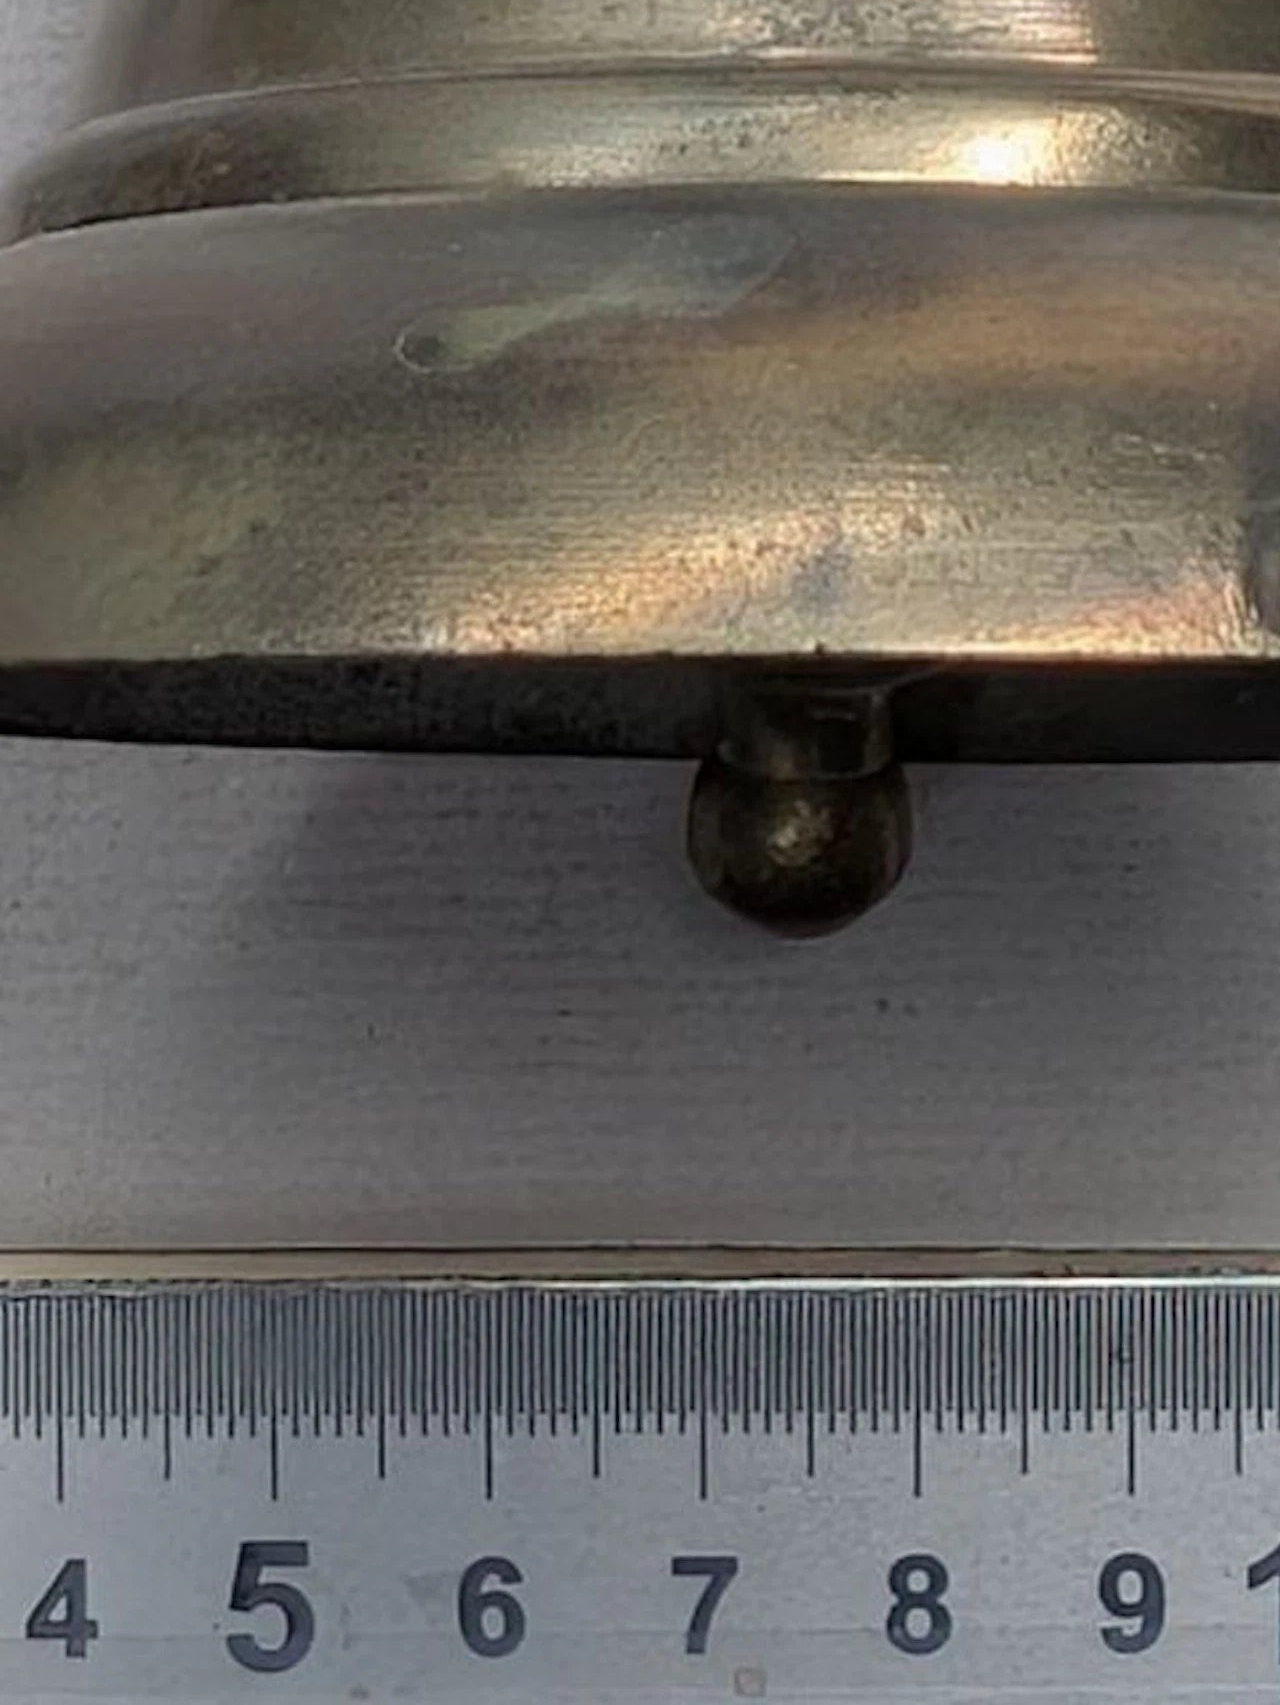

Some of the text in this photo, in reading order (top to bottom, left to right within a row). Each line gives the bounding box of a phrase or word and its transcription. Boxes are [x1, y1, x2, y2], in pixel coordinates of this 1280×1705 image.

[24, 1558, 98, 1657] 4
[225, 1540, 315, 1673] 5
[458, 1555, 524, 1656] 6
[670, 1555, 738, 1654] 7
[884, 1554, 952, 1654] 8
[1098, 1553, 1165, 1653] 9
